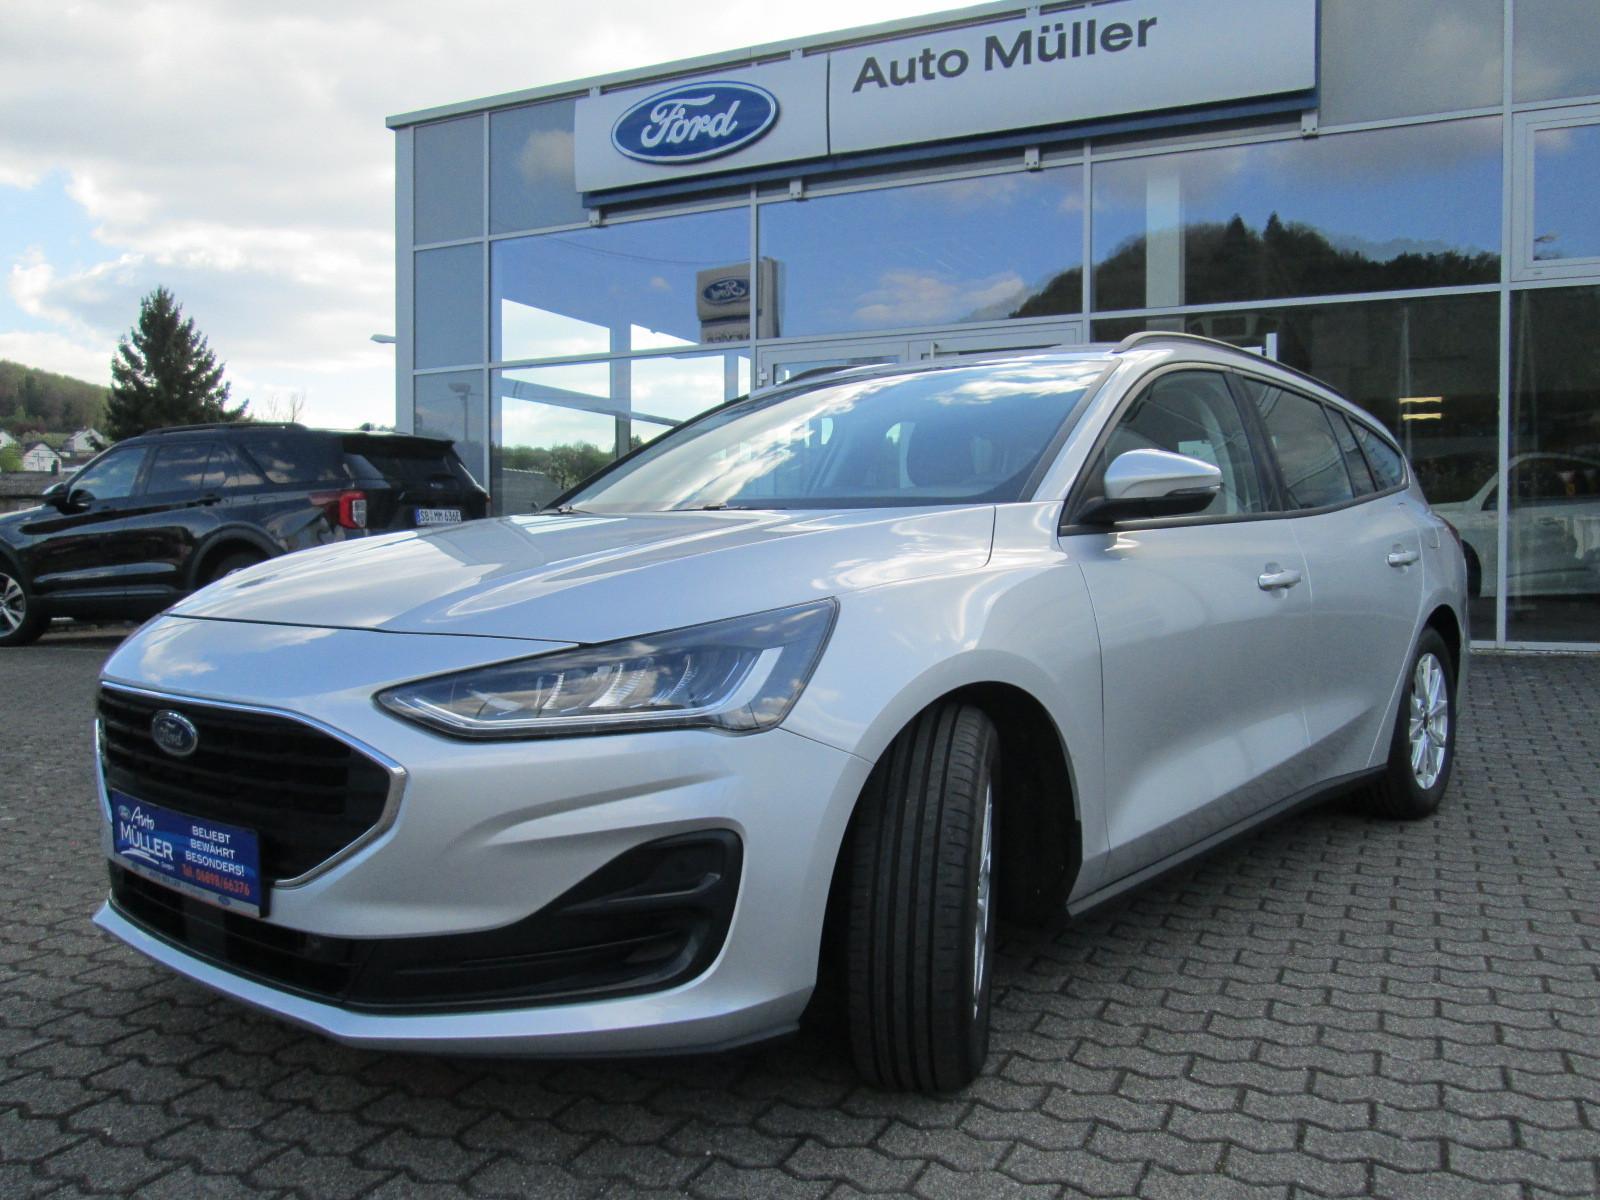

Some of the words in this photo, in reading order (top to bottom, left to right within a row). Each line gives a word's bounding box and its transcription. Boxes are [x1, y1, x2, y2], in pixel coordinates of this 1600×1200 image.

[852, 47, 970, 93] Auto
[984, 17, 1158, 72] Müller
[641, 94, 741, 148] Ford
[131, 806, 155, 831] Auto
[120, 821, 174, 861] MÜLLER
[192, 825, 231, 844] BELIEBT
[190, 838, 236, 860] BEWÄHRT
[185, 850, 245, 877] BESONDERS!
